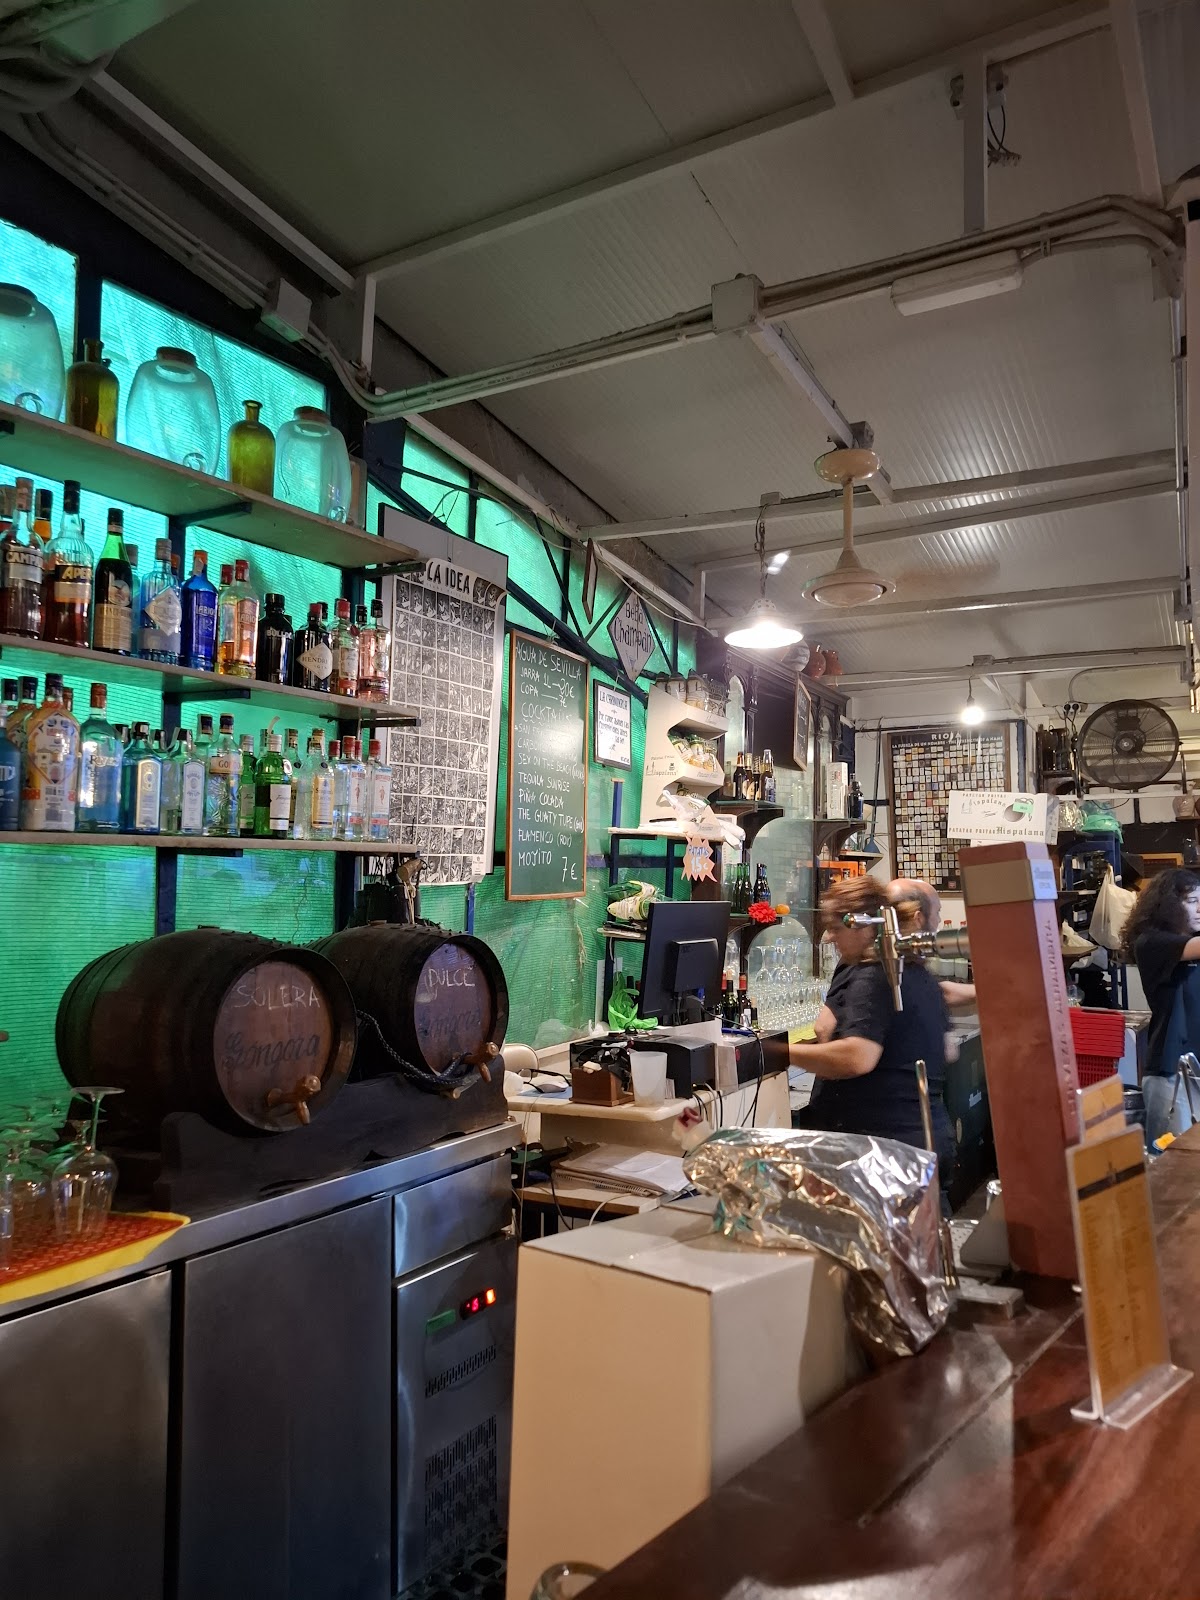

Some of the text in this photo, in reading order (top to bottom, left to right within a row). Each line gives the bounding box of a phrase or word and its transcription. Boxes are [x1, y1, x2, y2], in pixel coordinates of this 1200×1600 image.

[426, 561, 441, 584] LA
[445, 567, 470, 594] IDEA
[516, 641, 582, 681] AGUA DE SEVILLA
[520, 666, 540, 682] JARRA
[520, 682, 539, 697] COPA
[518, 753, 531, 765] SEX
[518, 771, 544, 786] TEQUILA
[518, 787, 564, 809] PIÑA COLADA
[517, 807, 531, 820] THE
[517, 828, 554, 844] FLAMENCO
[995, 826, 1044, 836] Hispalana
[518, 848, 552, 867] MOJITO
[427, 966, 476, 988] DULCE
[233, 984, 321, 1011] SOLERA
